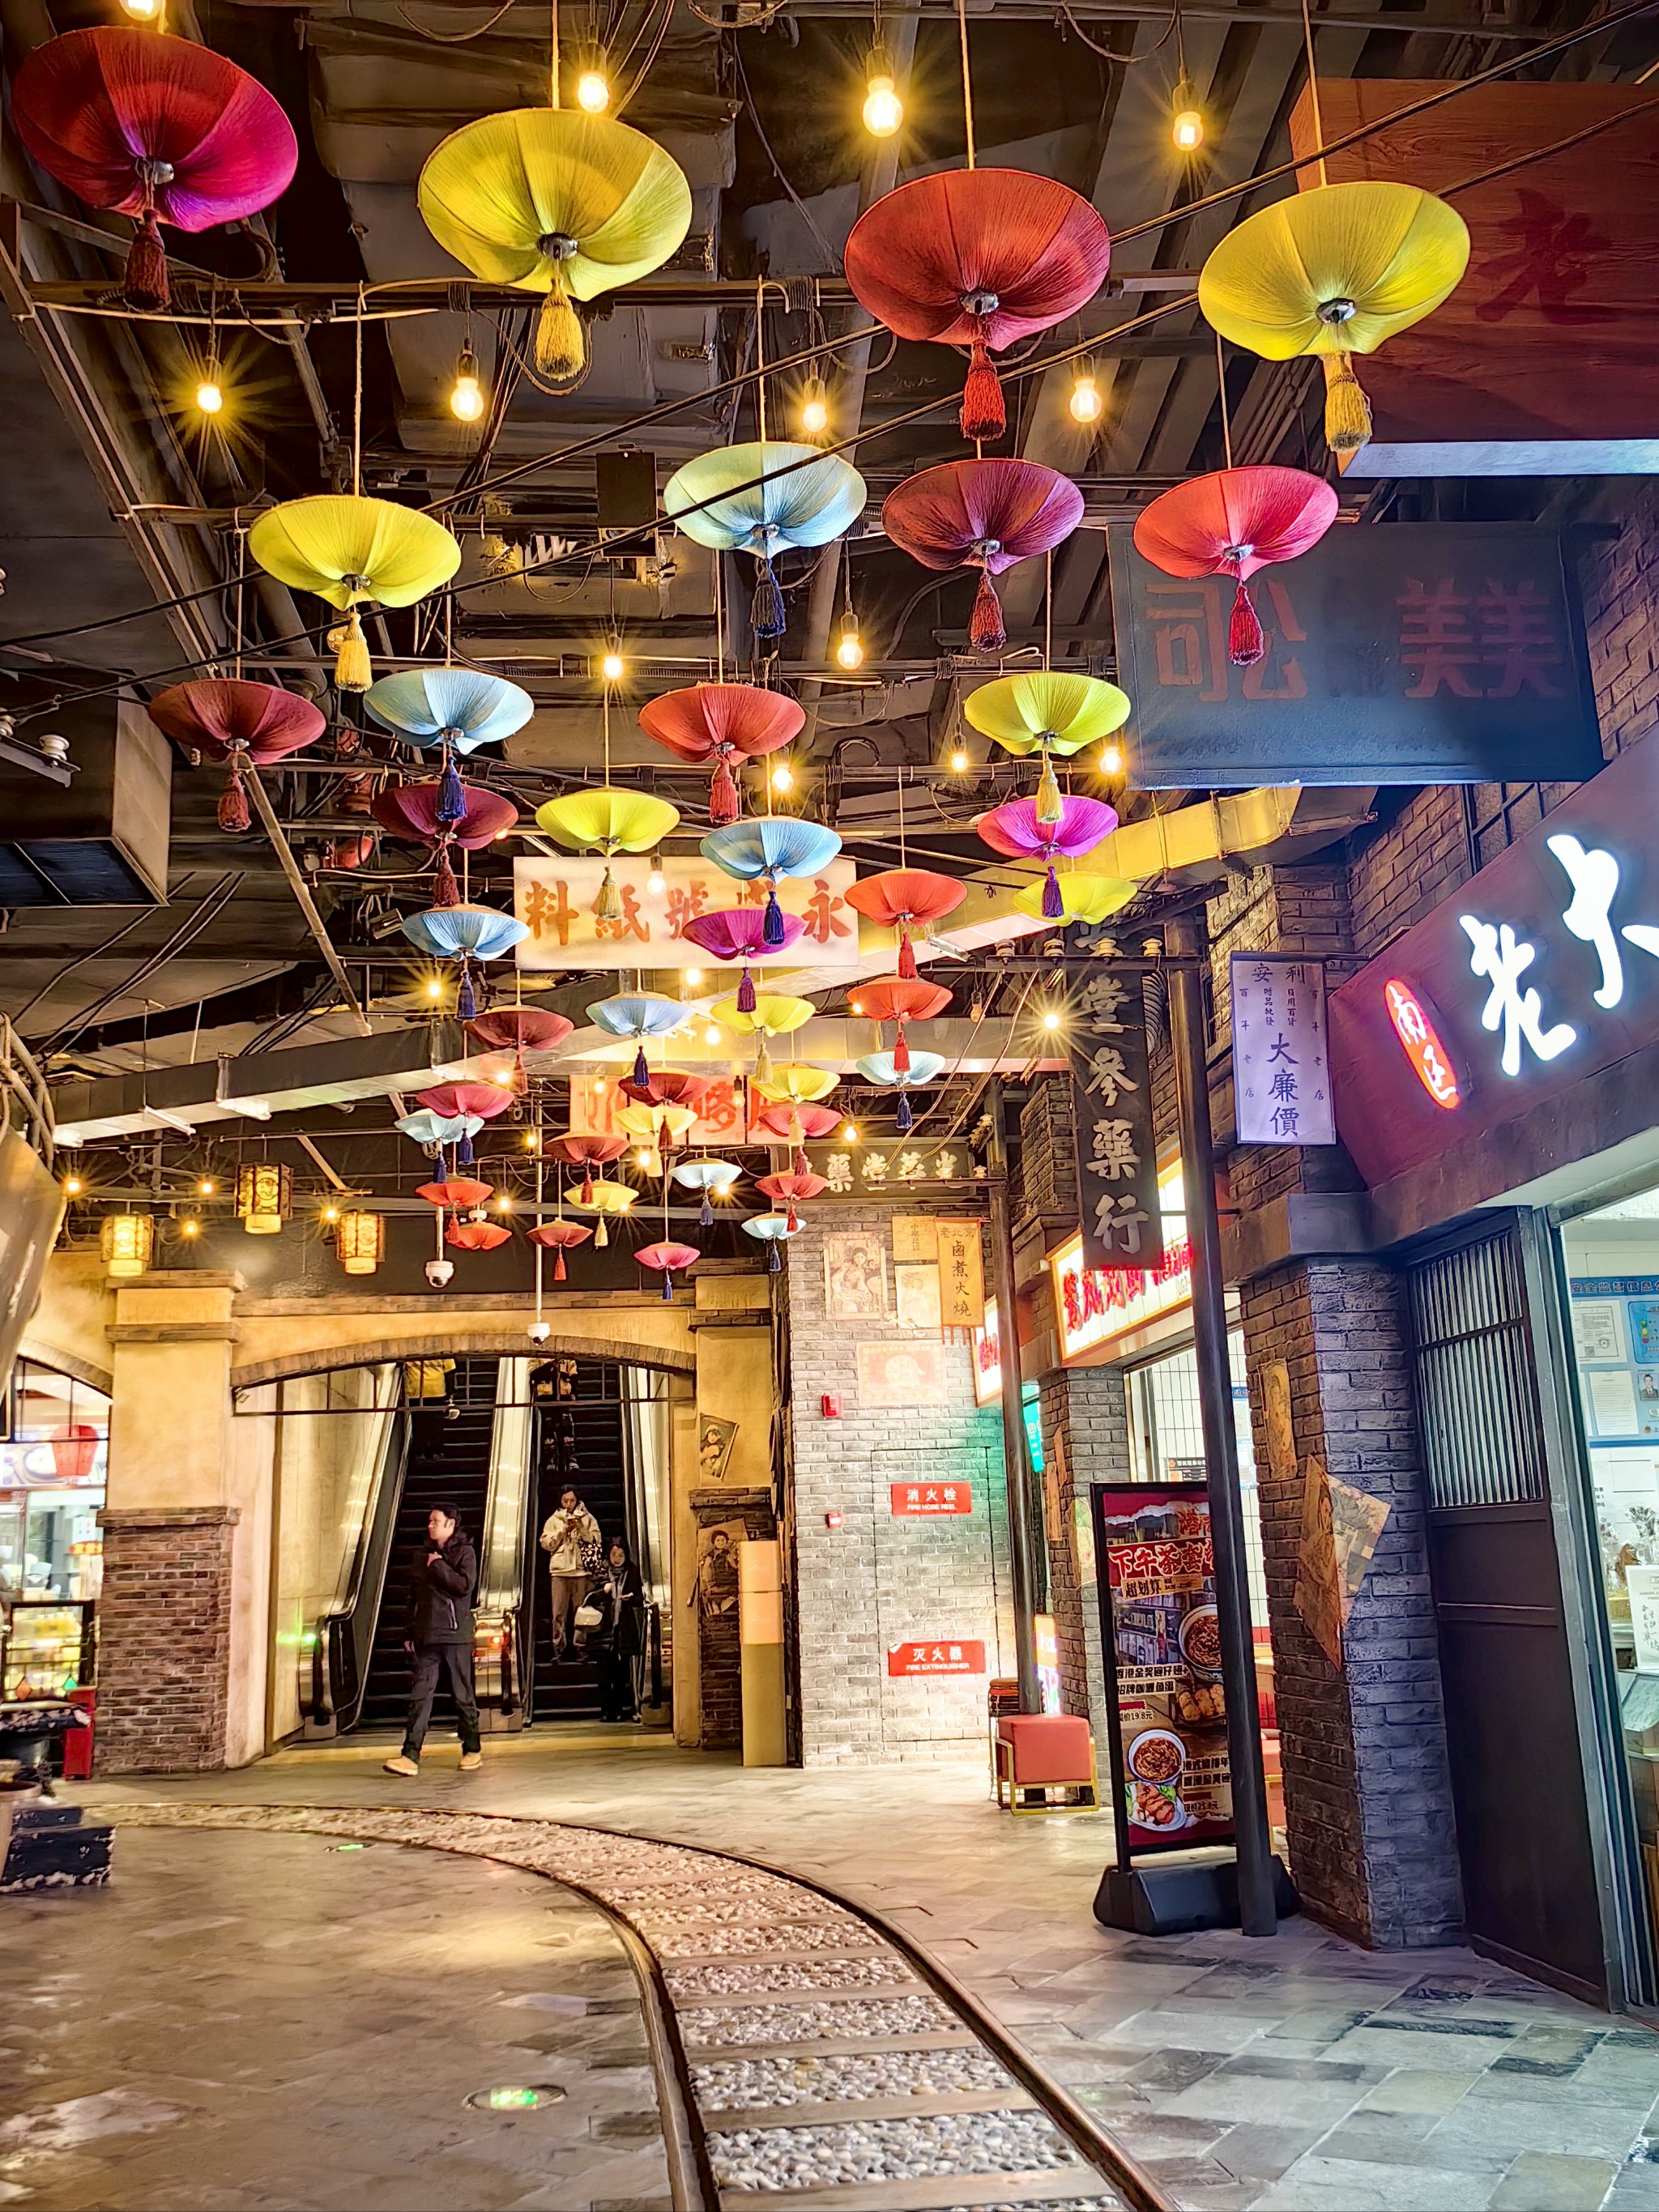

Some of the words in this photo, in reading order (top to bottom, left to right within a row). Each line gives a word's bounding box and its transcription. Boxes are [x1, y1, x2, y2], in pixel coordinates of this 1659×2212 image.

[1266, 1033, 1299, 1137] 大廉價
[940, 1227, 975, 1238] 老北京
[907, 1488, 957, 1502] 消火栓
[913, 1646, 962, 1662] 灭火器
[922, 1662, 970, 1670] EXTINGUISHER
